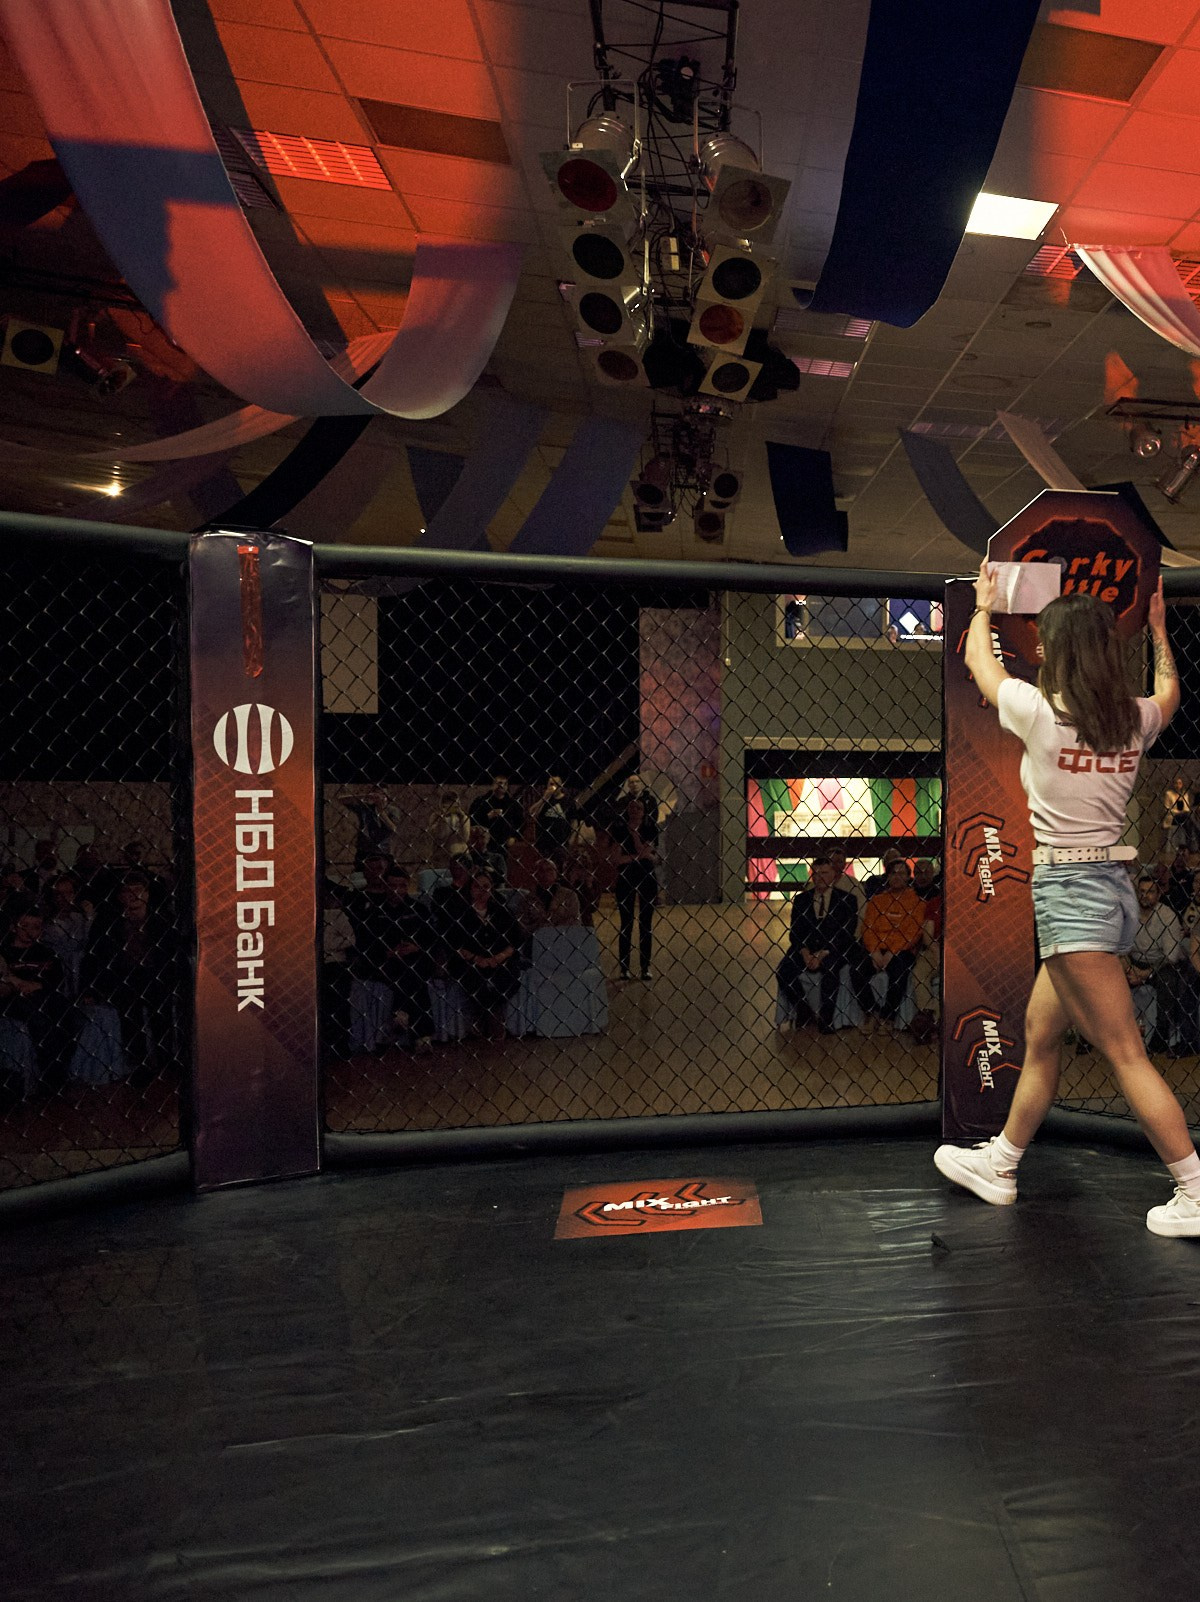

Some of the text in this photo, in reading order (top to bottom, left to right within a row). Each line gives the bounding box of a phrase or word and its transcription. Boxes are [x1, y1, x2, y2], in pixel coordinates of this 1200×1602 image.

[983, 827, 1004, 863] MIX
[979, 857, 996, 896] FIGHT
[235, 789, 275, 1012] НБД Банк
[982, 1020, 1003, 1056] MIX
[978, 1050, 995, 1089] FIGHT
[603, 1196, 732, 1212] MIX FIGHT
